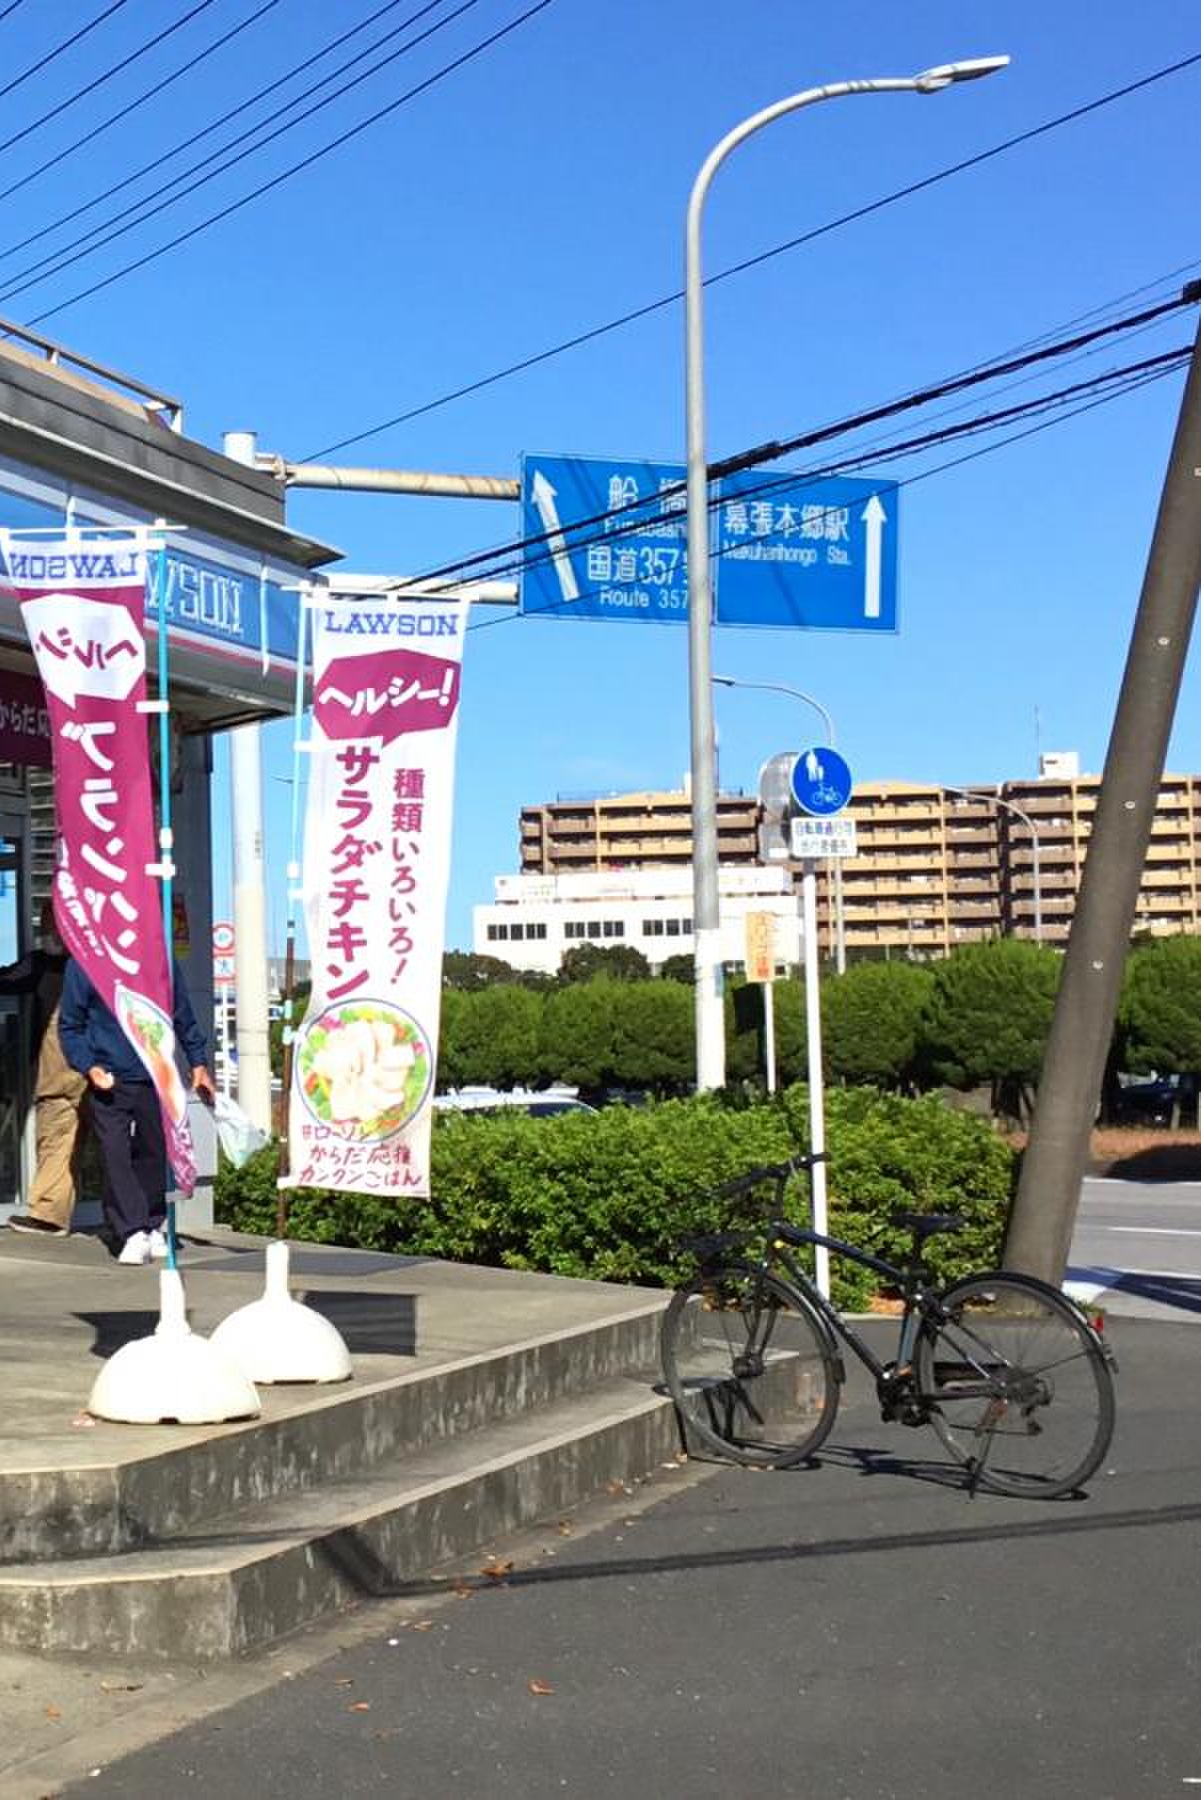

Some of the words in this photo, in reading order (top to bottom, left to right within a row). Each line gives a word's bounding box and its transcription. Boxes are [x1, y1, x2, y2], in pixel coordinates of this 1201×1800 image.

[725, 501, 849, 541] 幕張本郷駅
[588, 545, 687, 585] 国道357
[600, 587, 649, 607] Route
[325, 611, 459, 637] LAWSON
[319, 668, 454, 716] ヘルシー!
[326, 745, 383, 1001] サラダチキン
[388, 767, 425, 985] 種類いろいろ!
